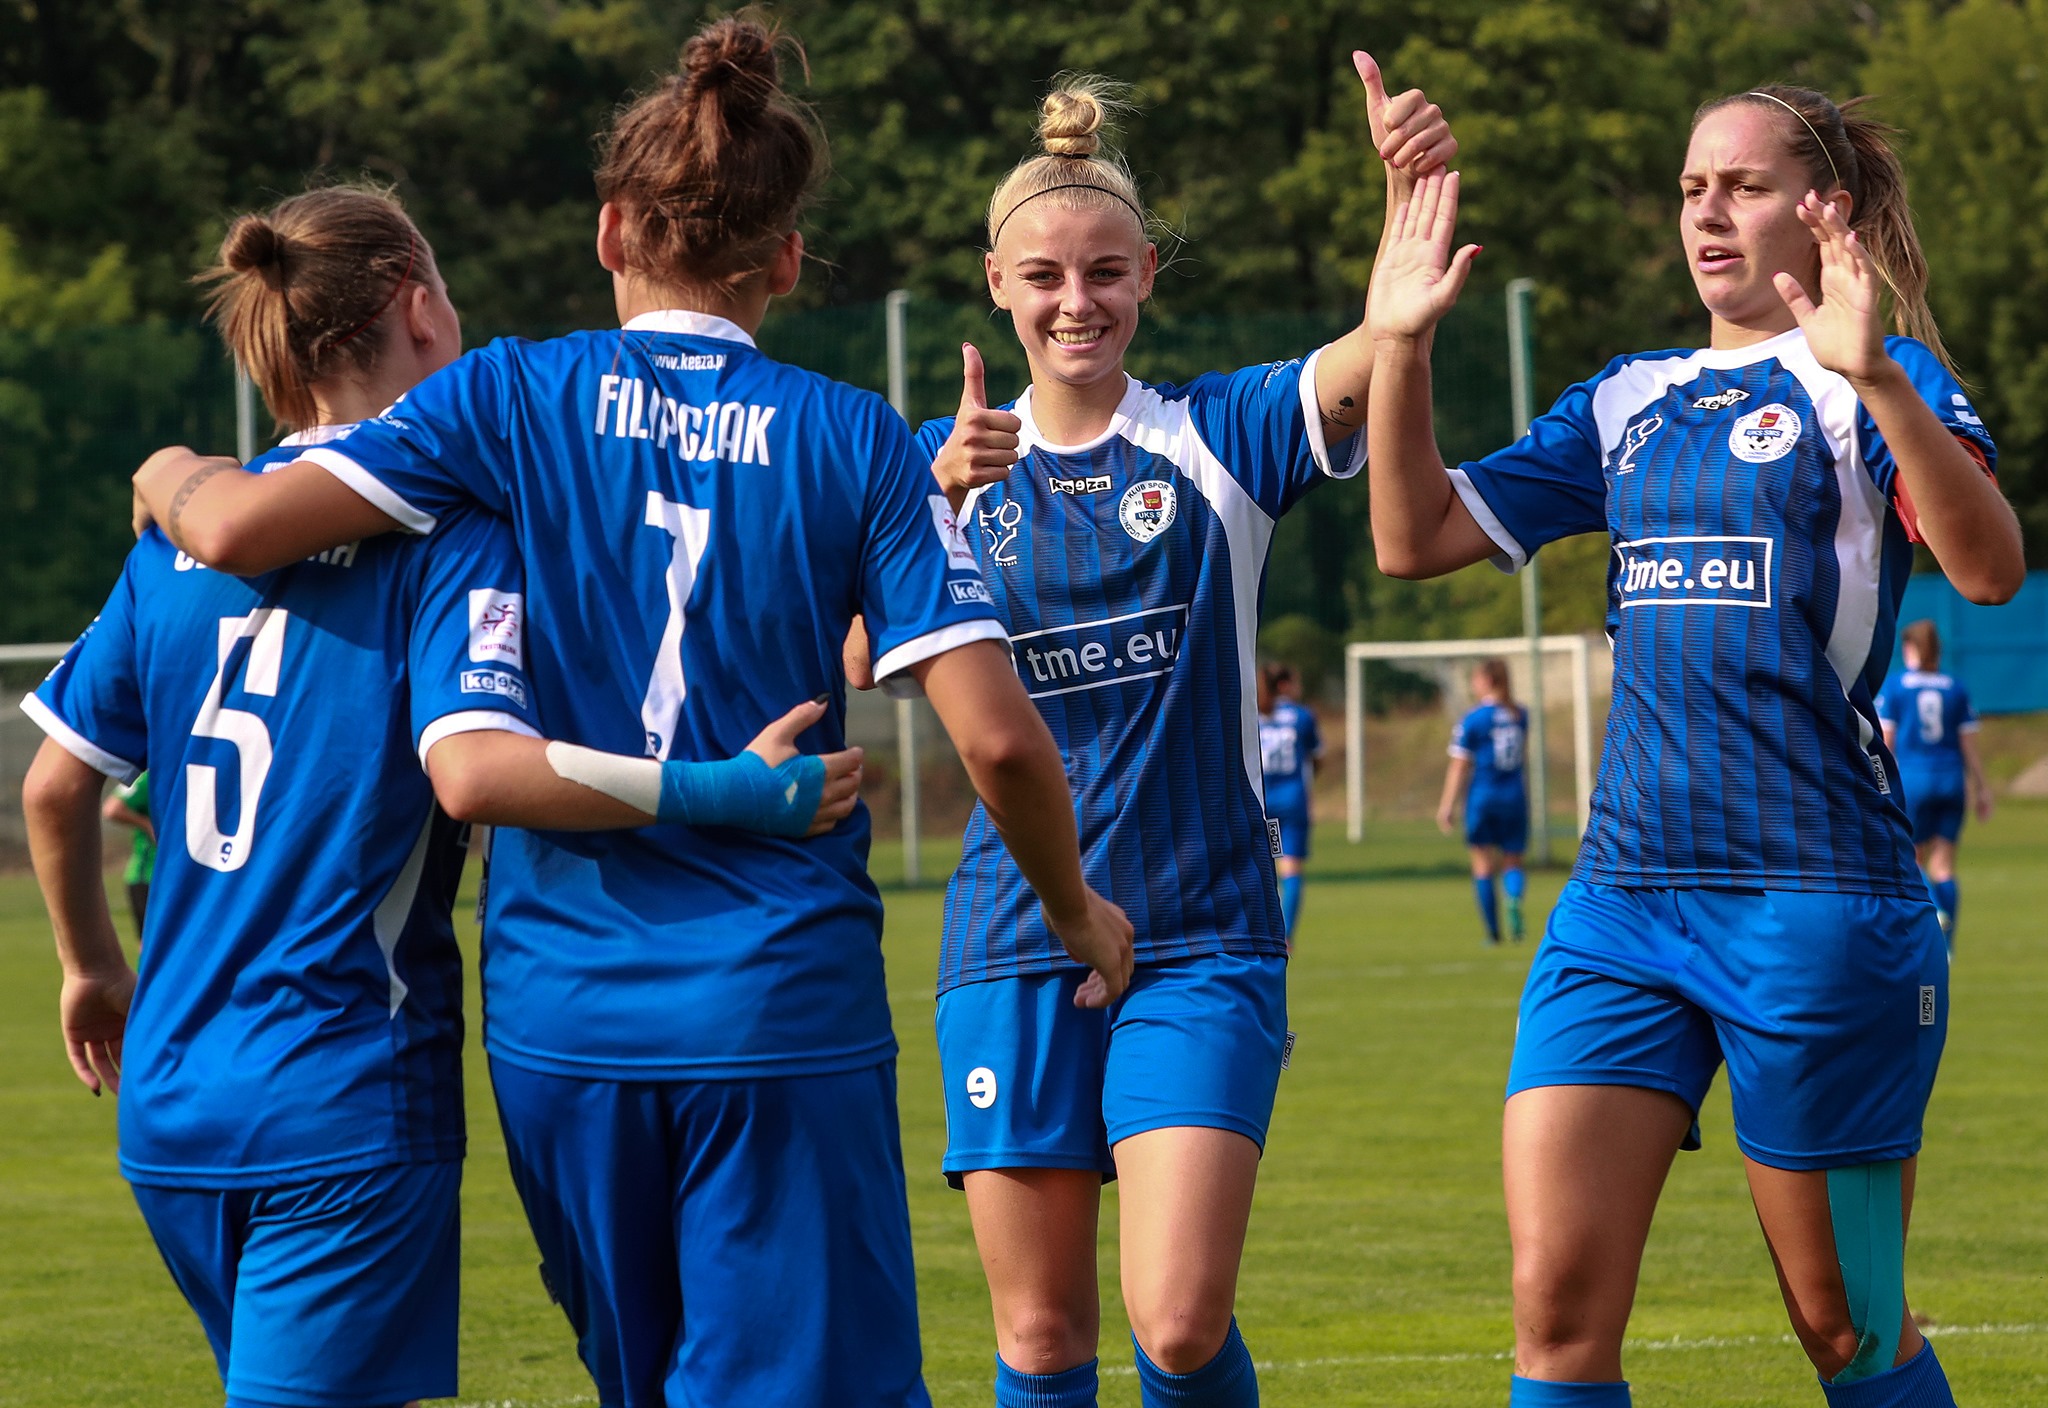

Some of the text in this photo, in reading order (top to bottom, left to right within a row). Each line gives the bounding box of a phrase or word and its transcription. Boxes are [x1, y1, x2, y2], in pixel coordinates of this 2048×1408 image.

[595, 374, 776, 466] FILIPCZAK
[1623, 556, 1756, 593] tme.eu
[641, 490, 711, 762] 7
[1026, 628, 1178, 682] tme.eu
[185, 607, 289, 873] 5
